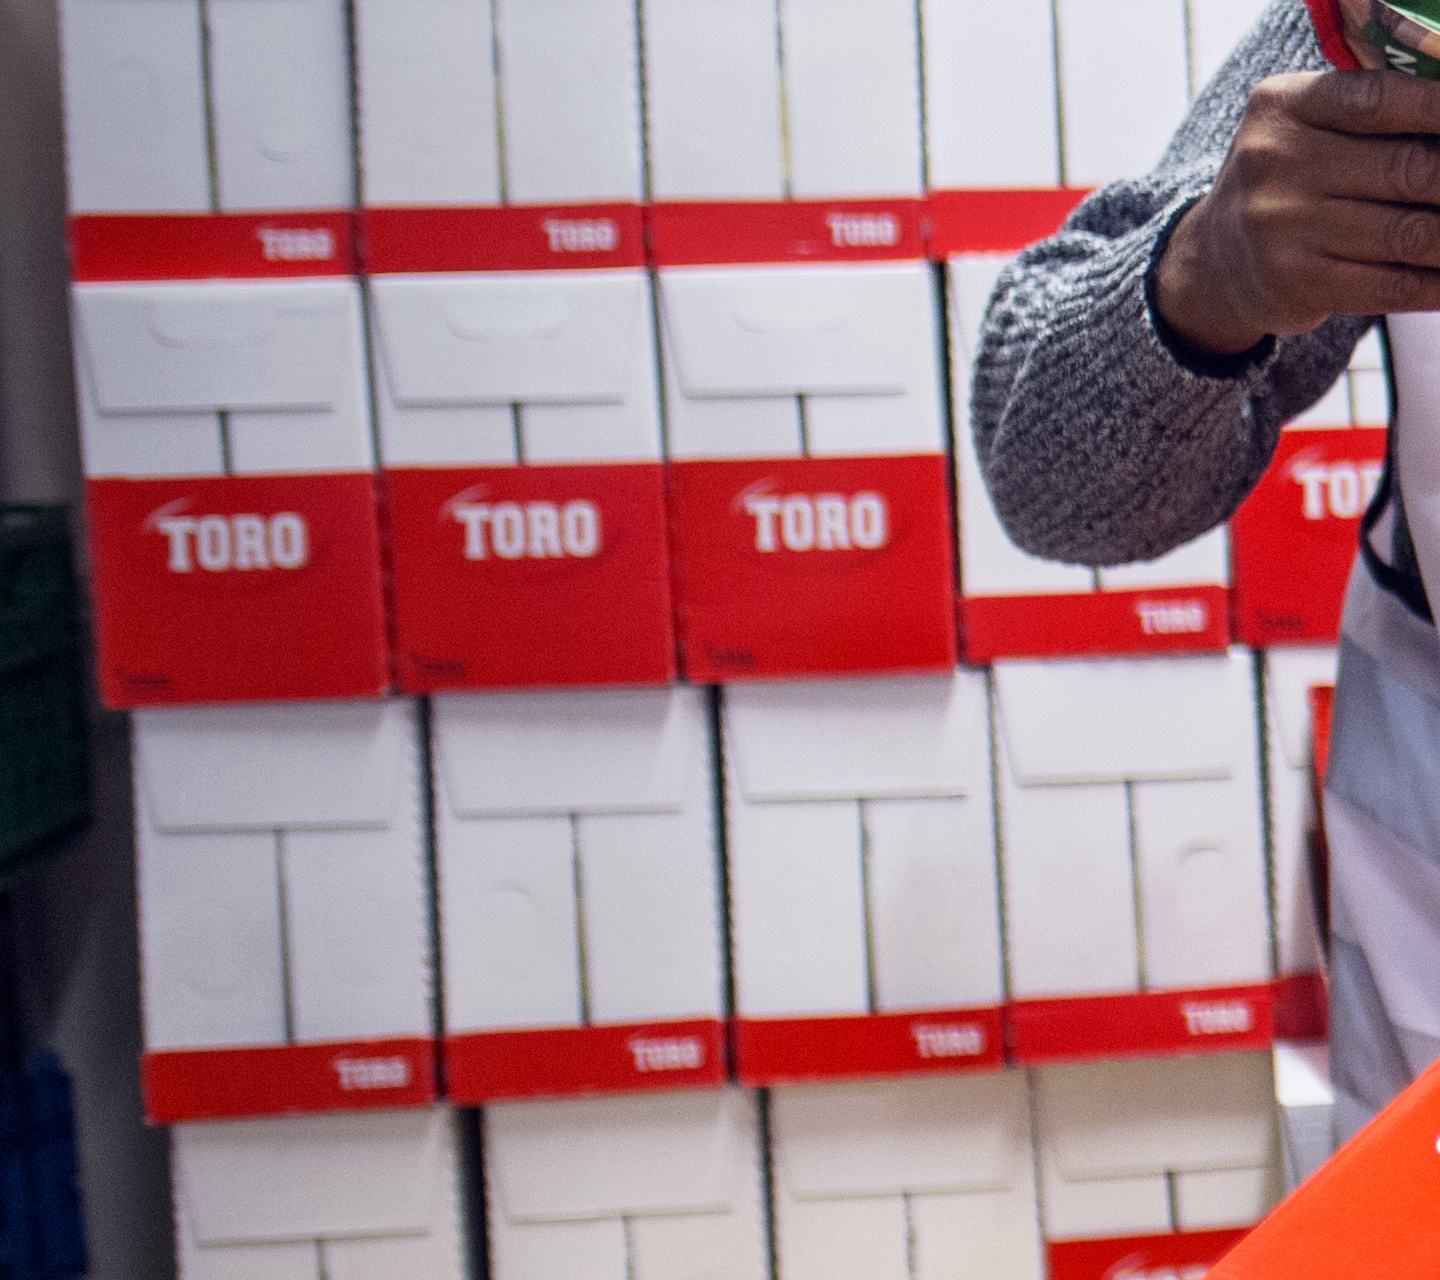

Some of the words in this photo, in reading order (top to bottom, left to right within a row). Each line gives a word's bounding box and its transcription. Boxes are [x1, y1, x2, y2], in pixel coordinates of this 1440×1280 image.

[260, 229, 334, 259] TORO
[545, 220, 616, 250] TORO
[829, 215, 897, 245] TORO
[1291, 458, 1380, 520] TO
[155, 513, 307, 572] TORO
[452, 501, 599, 559] TORO
[744, 493, 886, 551] TORO
[1138, 602, 1205, 632] TORO
